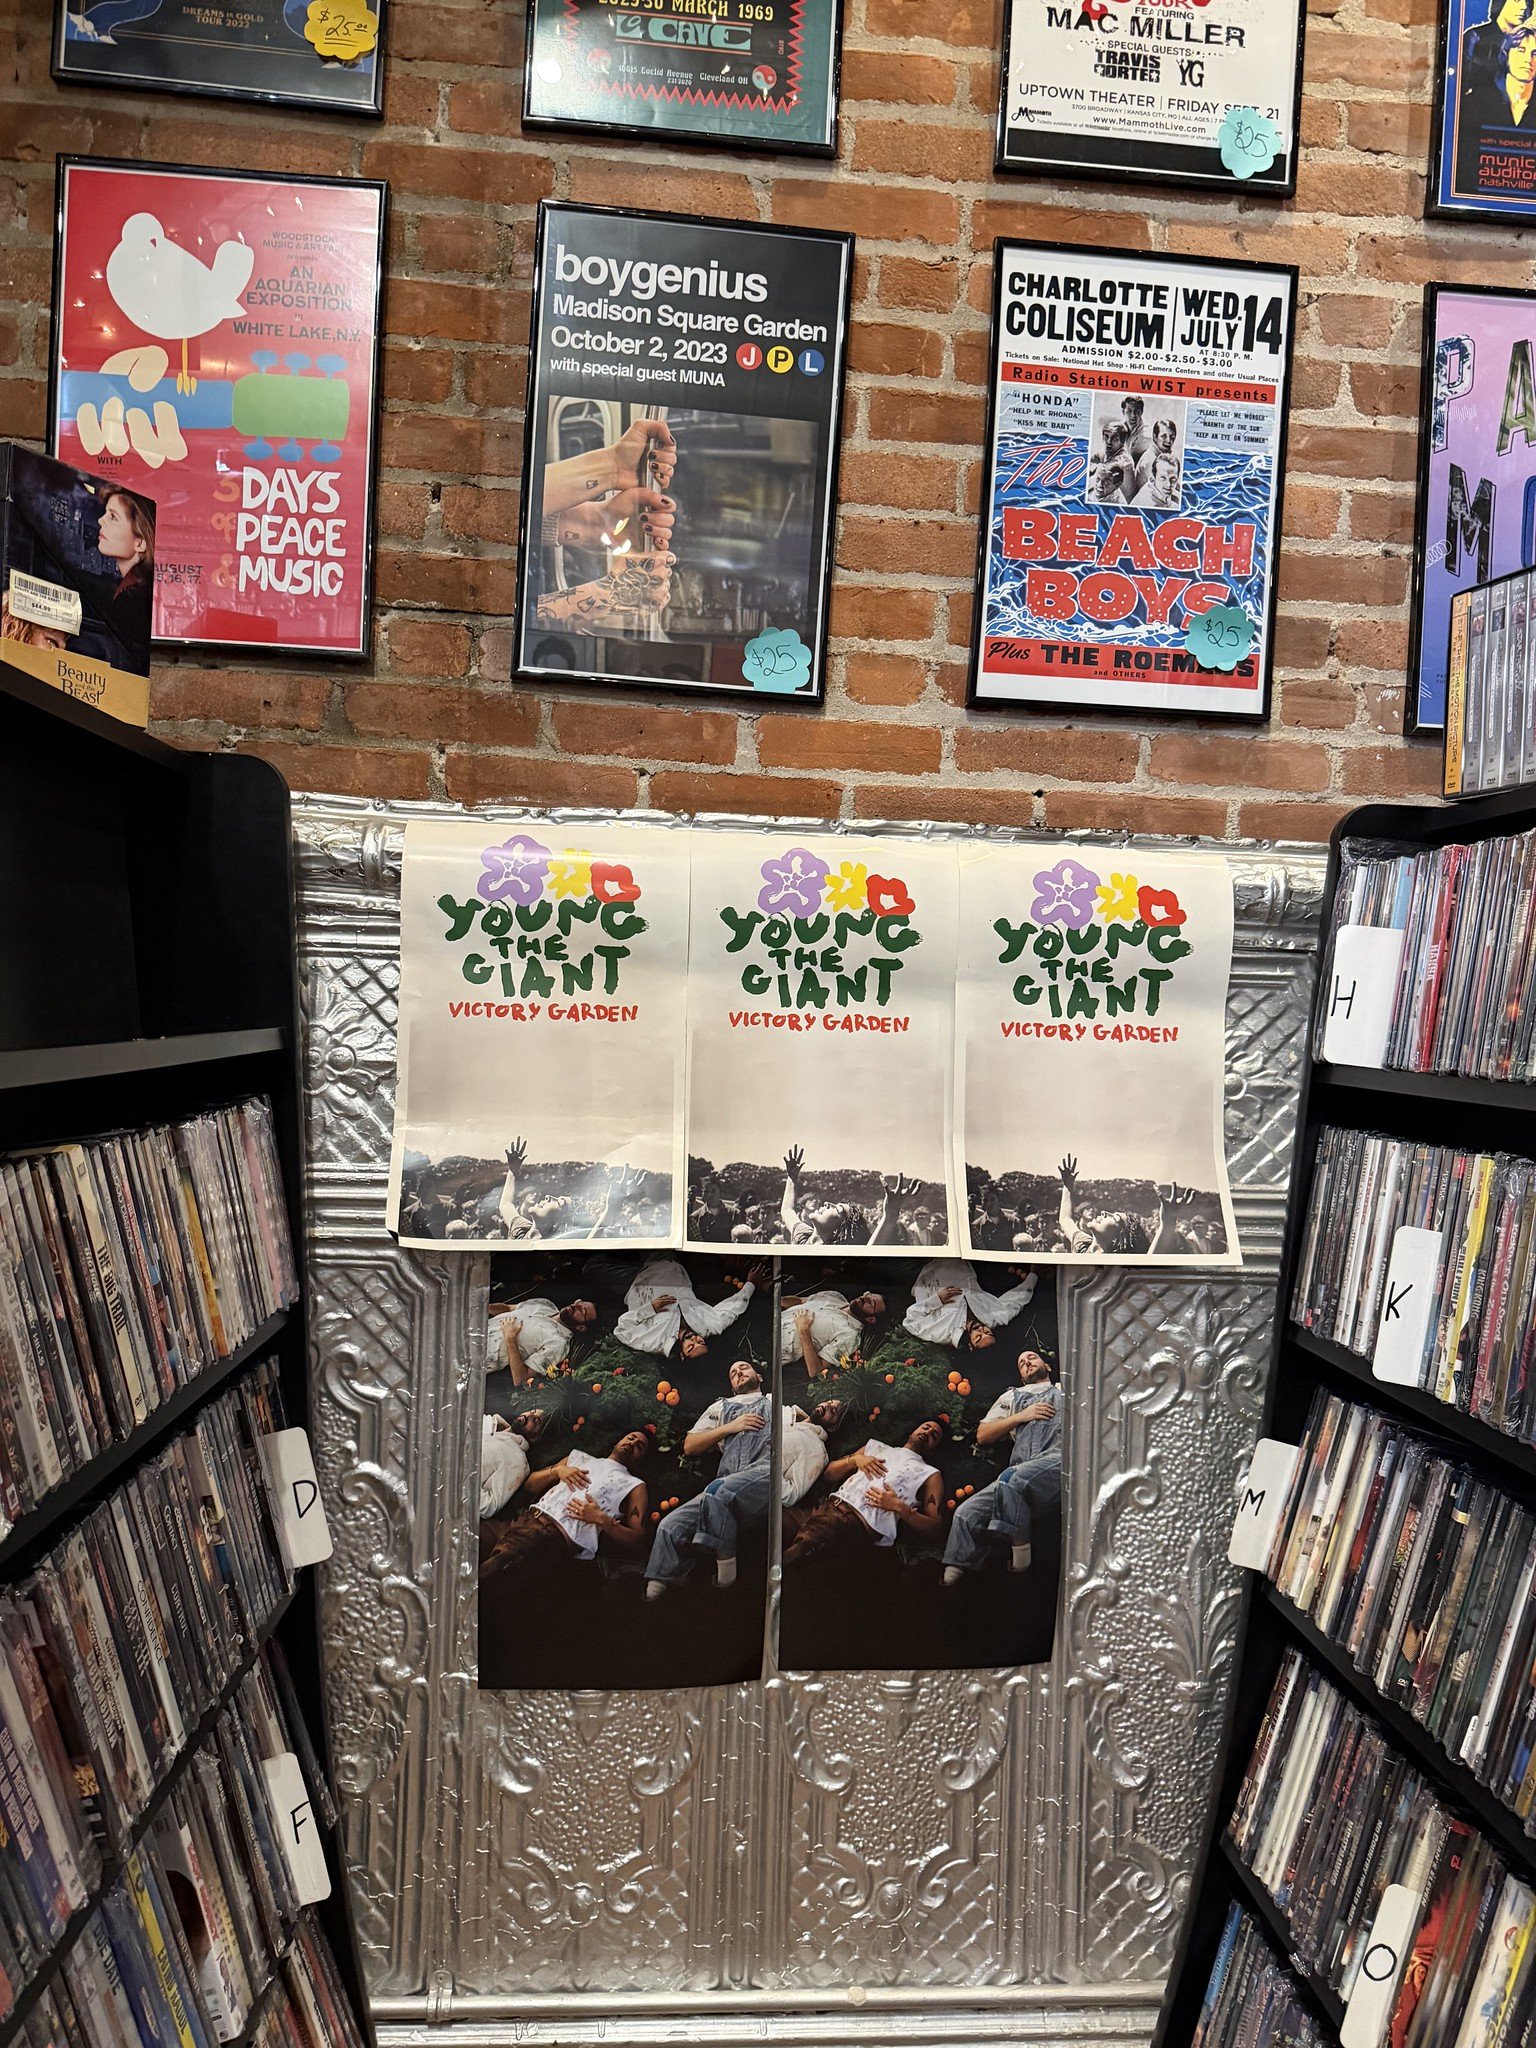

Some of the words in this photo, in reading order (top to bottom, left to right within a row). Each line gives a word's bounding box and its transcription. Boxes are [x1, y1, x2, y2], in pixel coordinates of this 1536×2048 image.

[183, 6, 225, 19] DREAMS
[236, 12, 264, 23] GOLD
[195, 15, 222, 25] TOUR
[226, 18, 251, 28] 2022
[671, 0, 728, 17] MARCH
[738, 4, 774, 21] 1969
[1134, 7, 1195, 20] FEATURING
[648, 17, 752, 50] CAVE
[1046, 6, 1119, 34] MAC
[1130, 16, 1246, 49] MILLER
[1108, 40, 1149, 53] SPECIAL
[1152, 45, 1192, 57] GUESTS
[640, 66, 664, 76] Euclid
[666, 69, 694, 79] Avenue
[699, 72, 735, 84] Cleveland
[737, 76, 749, 85] OH
[1095, 50, 1161, 69] TRAVIS
[1176, 58, 1204, 88] YG
[1019, 83, 1085, 101] UPTOWN
[1089, 90, 1155, 108] THEATER
[1168, 98, 1220, 114] FRIDAY
[1266, 108, 1280, 119] 21
[1087, 106, 1122, 115] BROADWAY
[1093, 116, 1206, 134] www.MammothLive.com
[1234, 121, 1269, 158] $25
[1499, 139, 1532, 149] special
[1479, 177, 1534, 190] nashville
[263, 239, 294, 248] MUSIC
[303, 242, 321, 251] ART
[272, 231, 335, 243] WOODSTOCK
[255, 278, 346, 296] AQUARIAN
[289, 265, 313, 279] AN
[554, 243, 769, 302] boygenius
[246, 291, 352, 312] EXPOSITION
[1008, 271, 1170, 310] CHARLOTTE
[1182, 287, 1243, 321] WED.
[1243, 295, 1283, 355] 14
[233, 321, 284, 337] WHITE
[553, 293, 651, 325] Madison
[656, 304, 740, 334] Square
[743, 313, 828, 343] Garden
[1005, 301, 1165, 350] COLISEUM
[1181, 319, 1239, 351] JULY
[550, 325, 645, 355] October
[648, 336, 668, 362] 2,
[673, 338, 728, 365] 2023
[743, 347, 756, 367] J
[773, 350, 788, 368] P
[804, 352, 819, 373] L
[1061, 345, 1123, 358] ADMISSION
[550, 357, 580, 373] with
[581, 361, 634, 379] special
[636, 367, 677, 383] guest
[679, 369, 726, 387] MUNA
[1005, 351, 1029, 360] Tickets
[1043, 355, 1060, 363] Sale:
[1062, 357, 1090, 366] National
[1107, 361, 1124, 370] Shop
[1147, 365, 1172, 373] Camera
[1175, 367, 1200, 376] Centers
[1203, 369, 1215, 377] and
[1218, 371, 1235, 379] other
[1237, 373, 1255, 381] Usual
[1258, 375, 1279, 383] Places
[1013, 366, 1059, 383] Radio
[1069, 372, 1129, 389] Station
[1140, 378, 1186, 394] WIST
[1196, 386, 1268, 400] presents
[97, 456, 123, 466] WITH
[1002, 436, 1088, 493] The
[241, 466, 342, 514] DAYS
[235, 512, 347, 557] PEACE
[1002, 505, 1256, 576] BEACH
[238, 555, 344, 597] MUSIC
[1026, 567, 1230, 632] BOYS
[1202, 619, 1241, 648] $25
[752, 644, 798, 676] $25
[987, 642, 1031, 661] Plus
[1040, 644, 1099, 666] THE
[57, 659, 107, 694] Beauty
[1112, 670, 1146, 679] OTHERS
[437, 894, 650, 942] YOUNG
[720, 906, 923, 953] YOUNG
[490, 934, 569, 961] THE
[993, 917, 1195, 964] YOUNG
[462, 945, 630, 998] GIANT
[768, 947, 844, 972] THE
[1040, 957, 1114, 983] THE
[741, 958, 904, 1009] GIANT
[1013, 968, 1174, 1019] GIANT
[1330, 975, 1356, 1020] H
[449, 1002, 541, 1022] VICTORY
[547, 1003, 639, 1023] GARDEN
[729, 1012, 816, 1031] VICTORY
[823, 1014, 910, 1033] GARDEN
[1001, 1022, 1087, 1041] VICTORY
[1093, 1024, 1179, 1043] GARDEN
[97, 1241, 112, 1271] THE
[102, 1271, 117, 1294] BIG
[109, 1295, 128, 1336] TRAIL
[1385, 1280, 1414, 1322] K
[32, 1331, 45, 1366] HILLS
[292, 1479, 318, 1519] D
[1240, 1488, 1266, 1516] M
[164, 1505, 178, 1551] CONTACT
[138, 1580, 162, 1667] CONFIDENCE
[23, 1799, 40, 1833] DANGER
[290, 1801, 311, 1845] F
[1376, 1820, 1383, 1830] NO
[1364, 1830, 1379, 1872] COUNTRY
[1354, 1883, 1363, 1900] OLD
[1346, 1902, 1356, 1926] MEN
[94, 1925, 109, 1958] DUE
[103, 1958, 121, 1997] DATE
[1363, 1943, 1398, 1981] O
